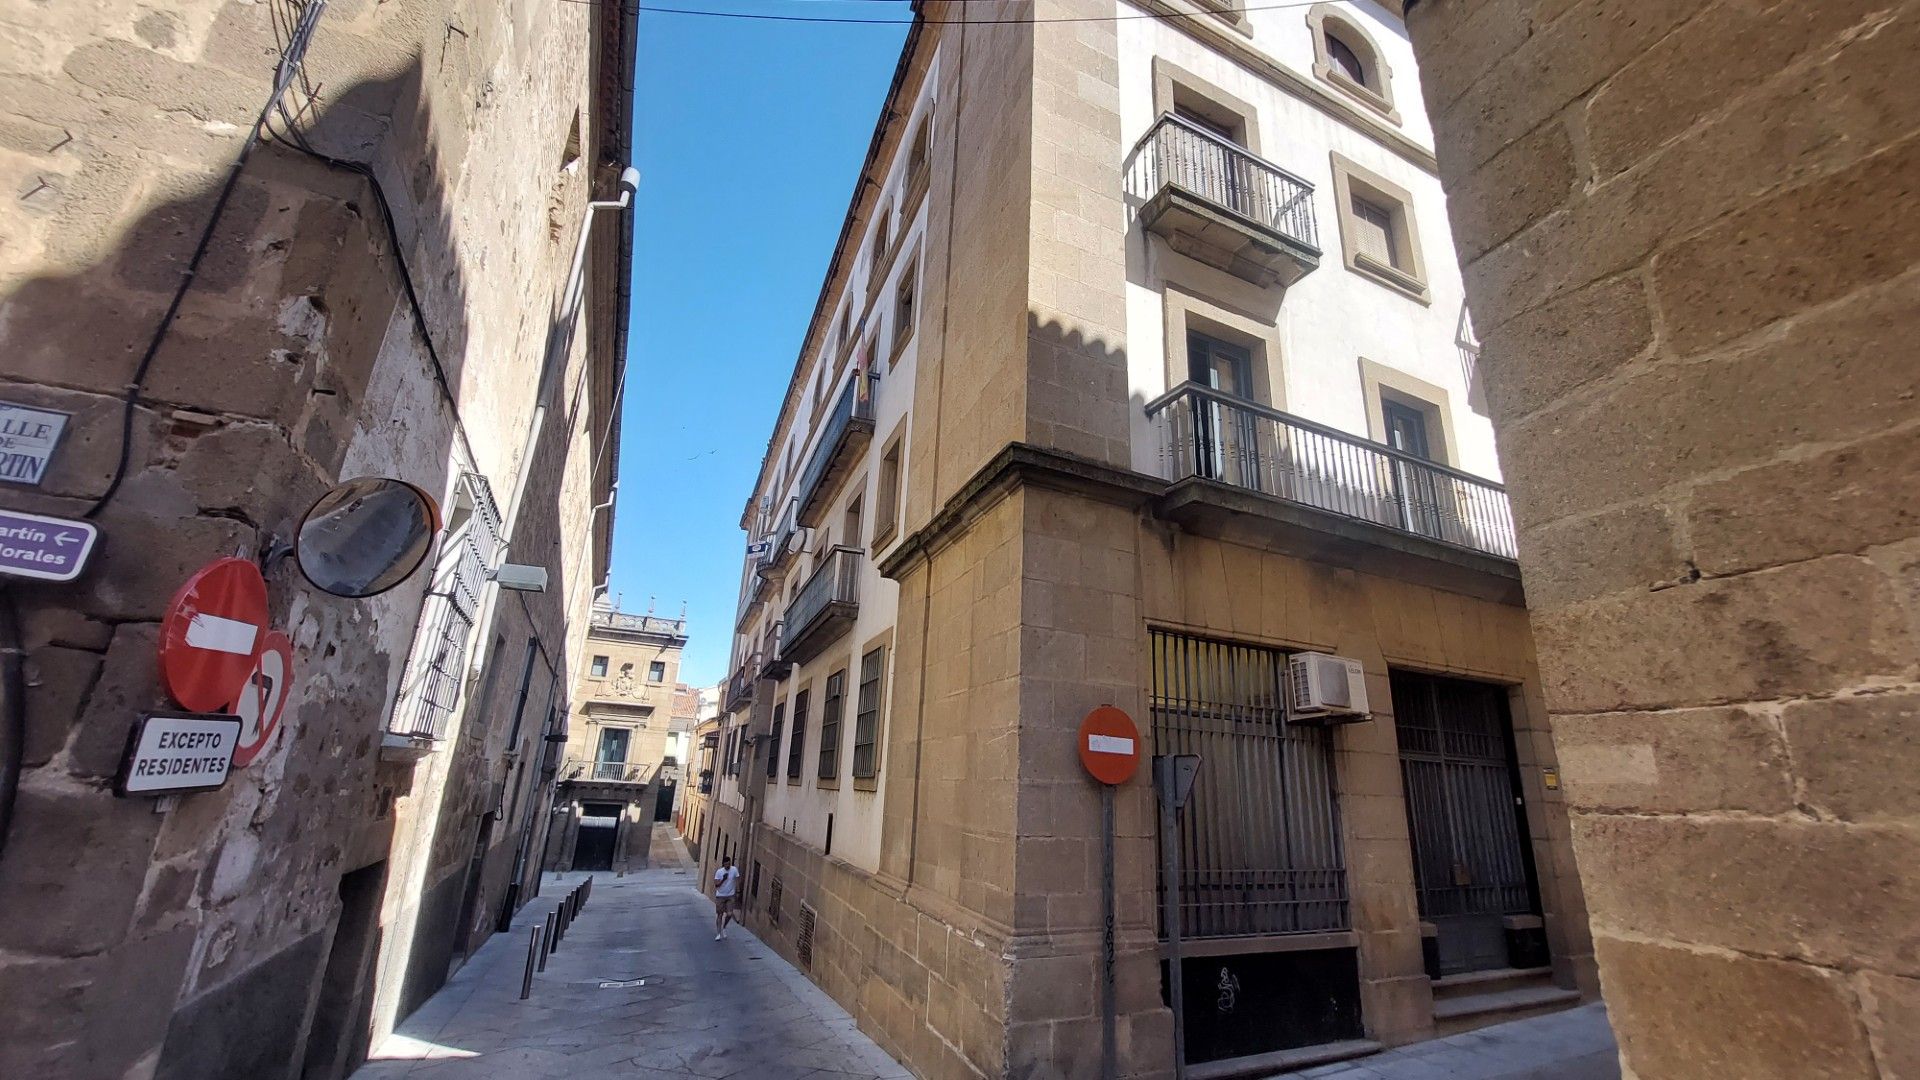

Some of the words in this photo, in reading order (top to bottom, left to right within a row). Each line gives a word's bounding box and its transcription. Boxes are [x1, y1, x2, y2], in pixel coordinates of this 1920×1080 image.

[0, 543, 66, 565] orales
[158, 732, 221, 749] EXCEPTO
[136, 757, 226, 776] RESIDENTES
